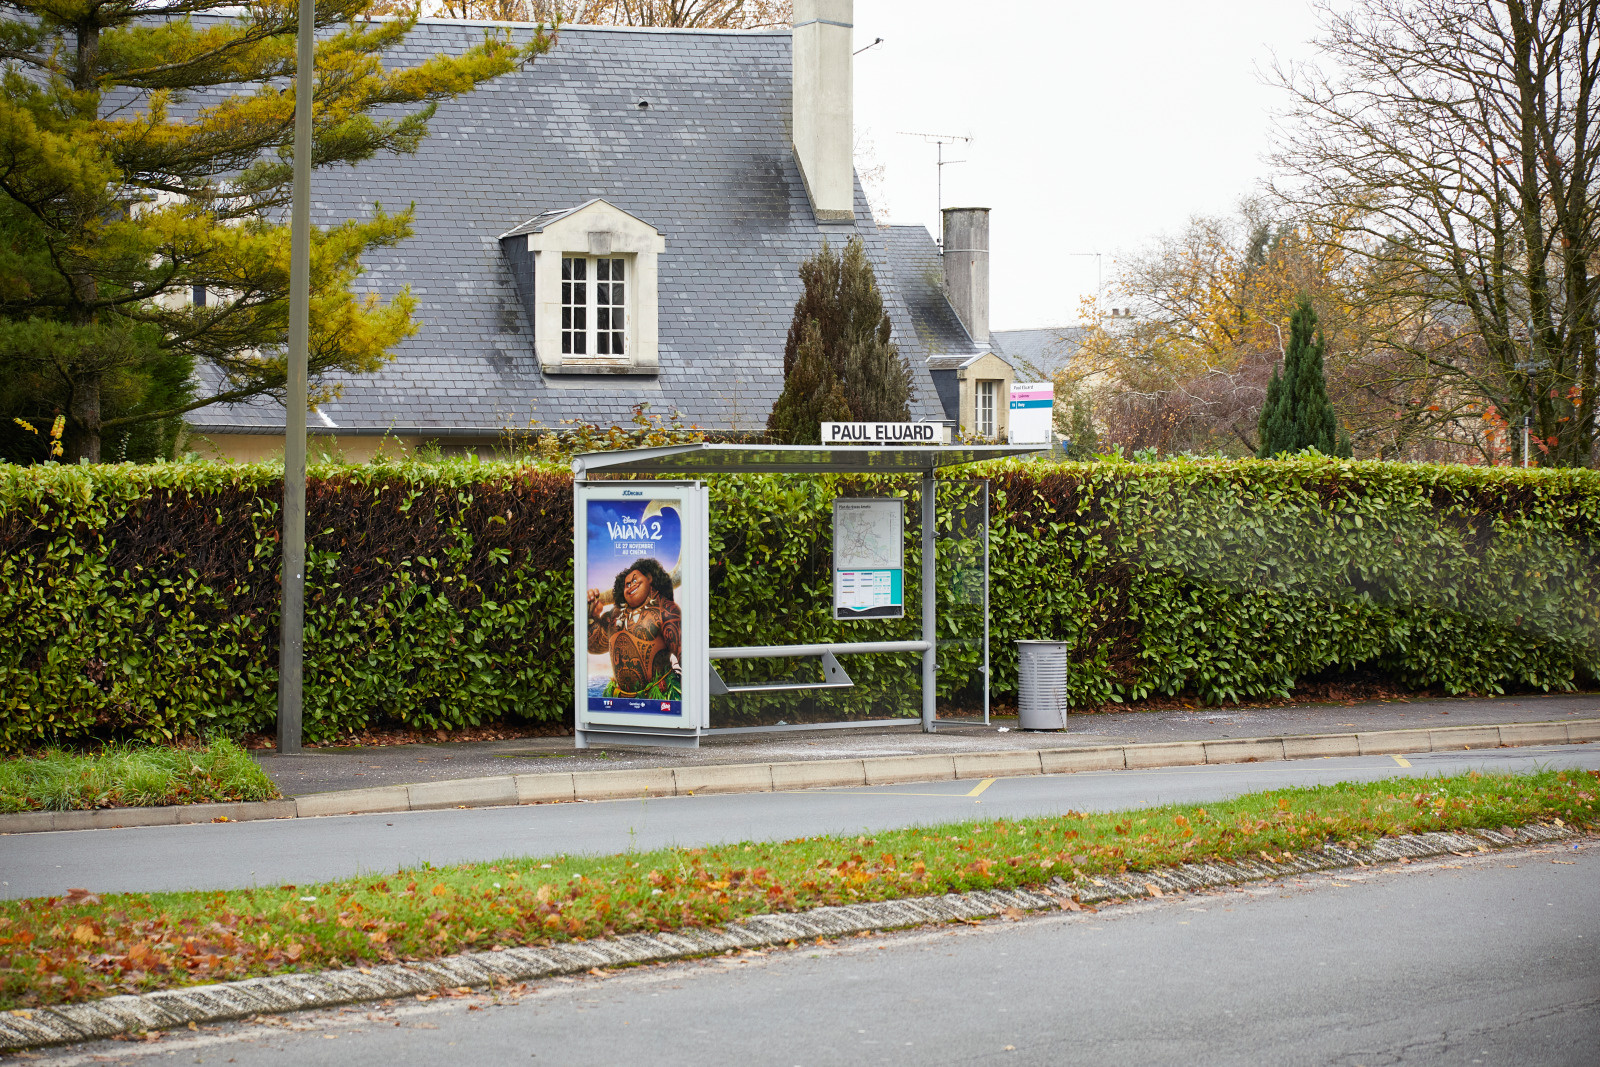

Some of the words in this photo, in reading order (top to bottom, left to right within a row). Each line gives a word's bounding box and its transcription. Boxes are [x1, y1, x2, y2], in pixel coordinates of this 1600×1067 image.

[832, 425, 871, 440] PAUL
[876, 425, 934, 440] ELUARD
[622, 516, 638, 525] Disney
[607, 522, 650, 540] VAIANA
[650, 522, 662, 540] 2
